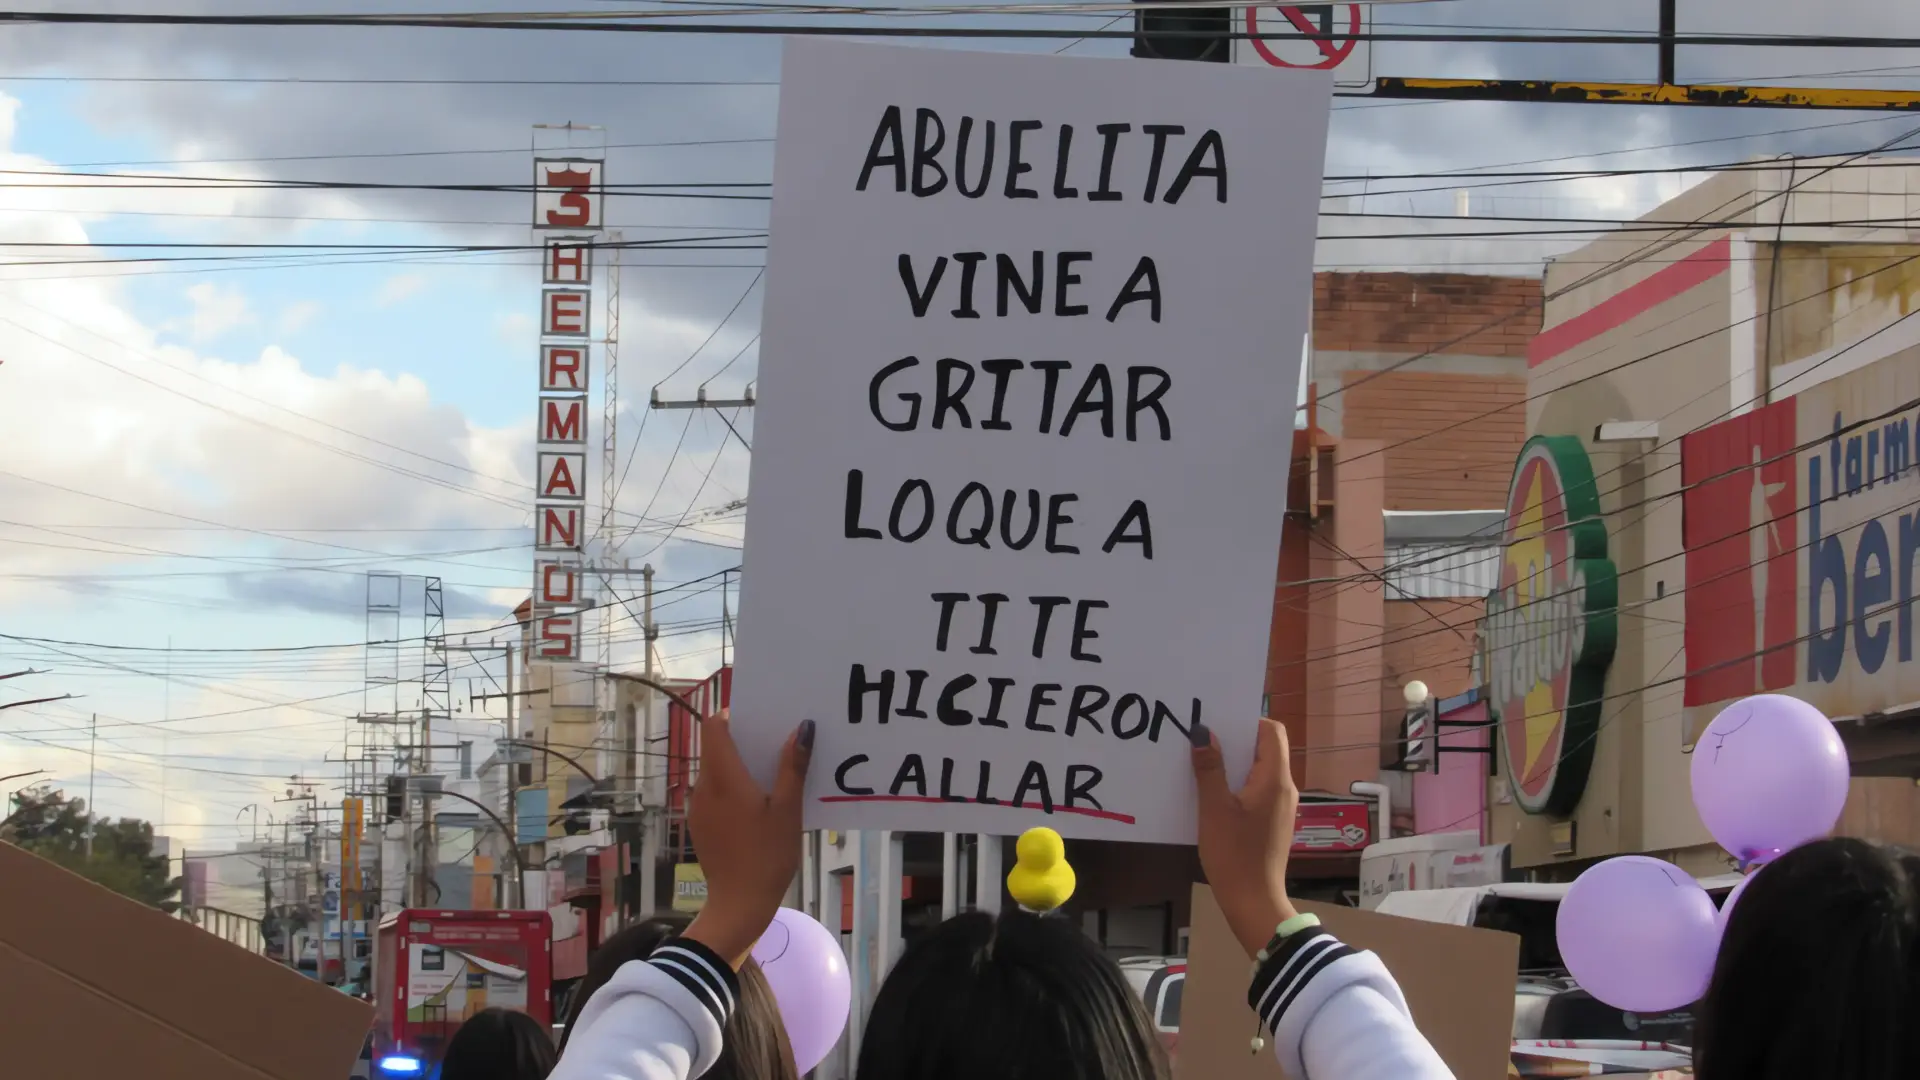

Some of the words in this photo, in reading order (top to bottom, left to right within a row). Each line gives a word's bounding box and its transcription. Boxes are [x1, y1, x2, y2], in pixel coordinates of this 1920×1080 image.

[855, 104, 1228, 205] ABUELITA
[898, 250, 1093, 319] VINE
[1105, 255, 1162, 324] A
[868, 355, 1172, 442] GRITAR
[541, 243, 583, 656] HERMANOS
[1101, 499, 1153, 560] A
[847, 663, 1202, 743] HICIERON
[833, 753, 1105, 815] CALLAR
